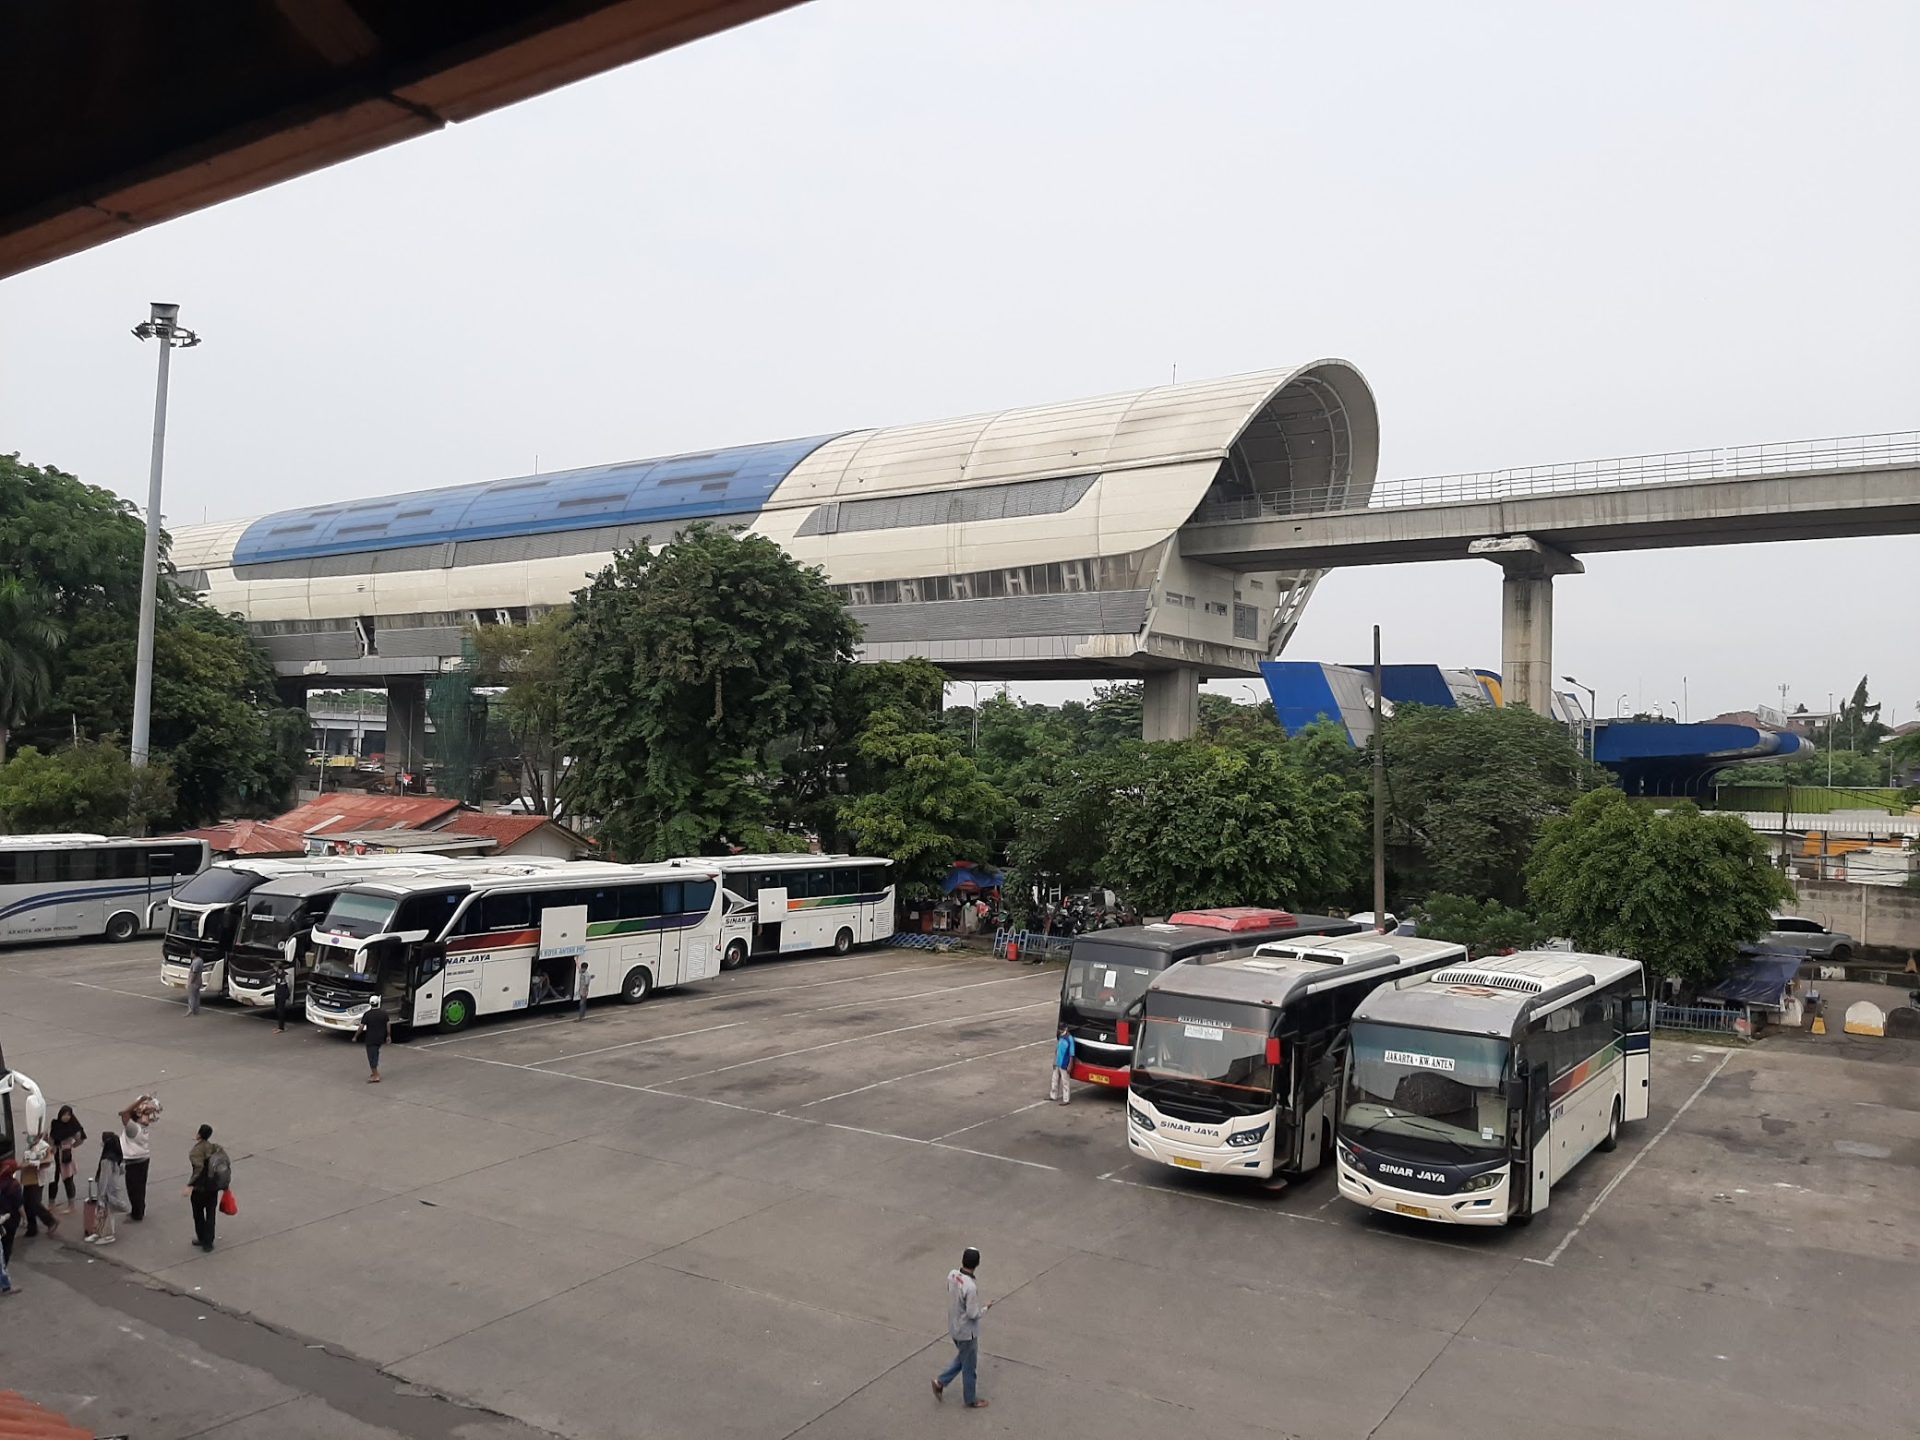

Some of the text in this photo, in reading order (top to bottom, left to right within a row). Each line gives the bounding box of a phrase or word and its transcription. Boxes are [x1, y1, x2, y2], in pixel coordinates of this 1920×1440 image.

[446, 954, 491, 965] NAR JAYA
[1386, 1051, 1414, 1065] JAKARTA
[1160, 1120, 1220, 1138] SINAR JAYA
[1378, 1163, 1446, 1184] SINAR JAYA
